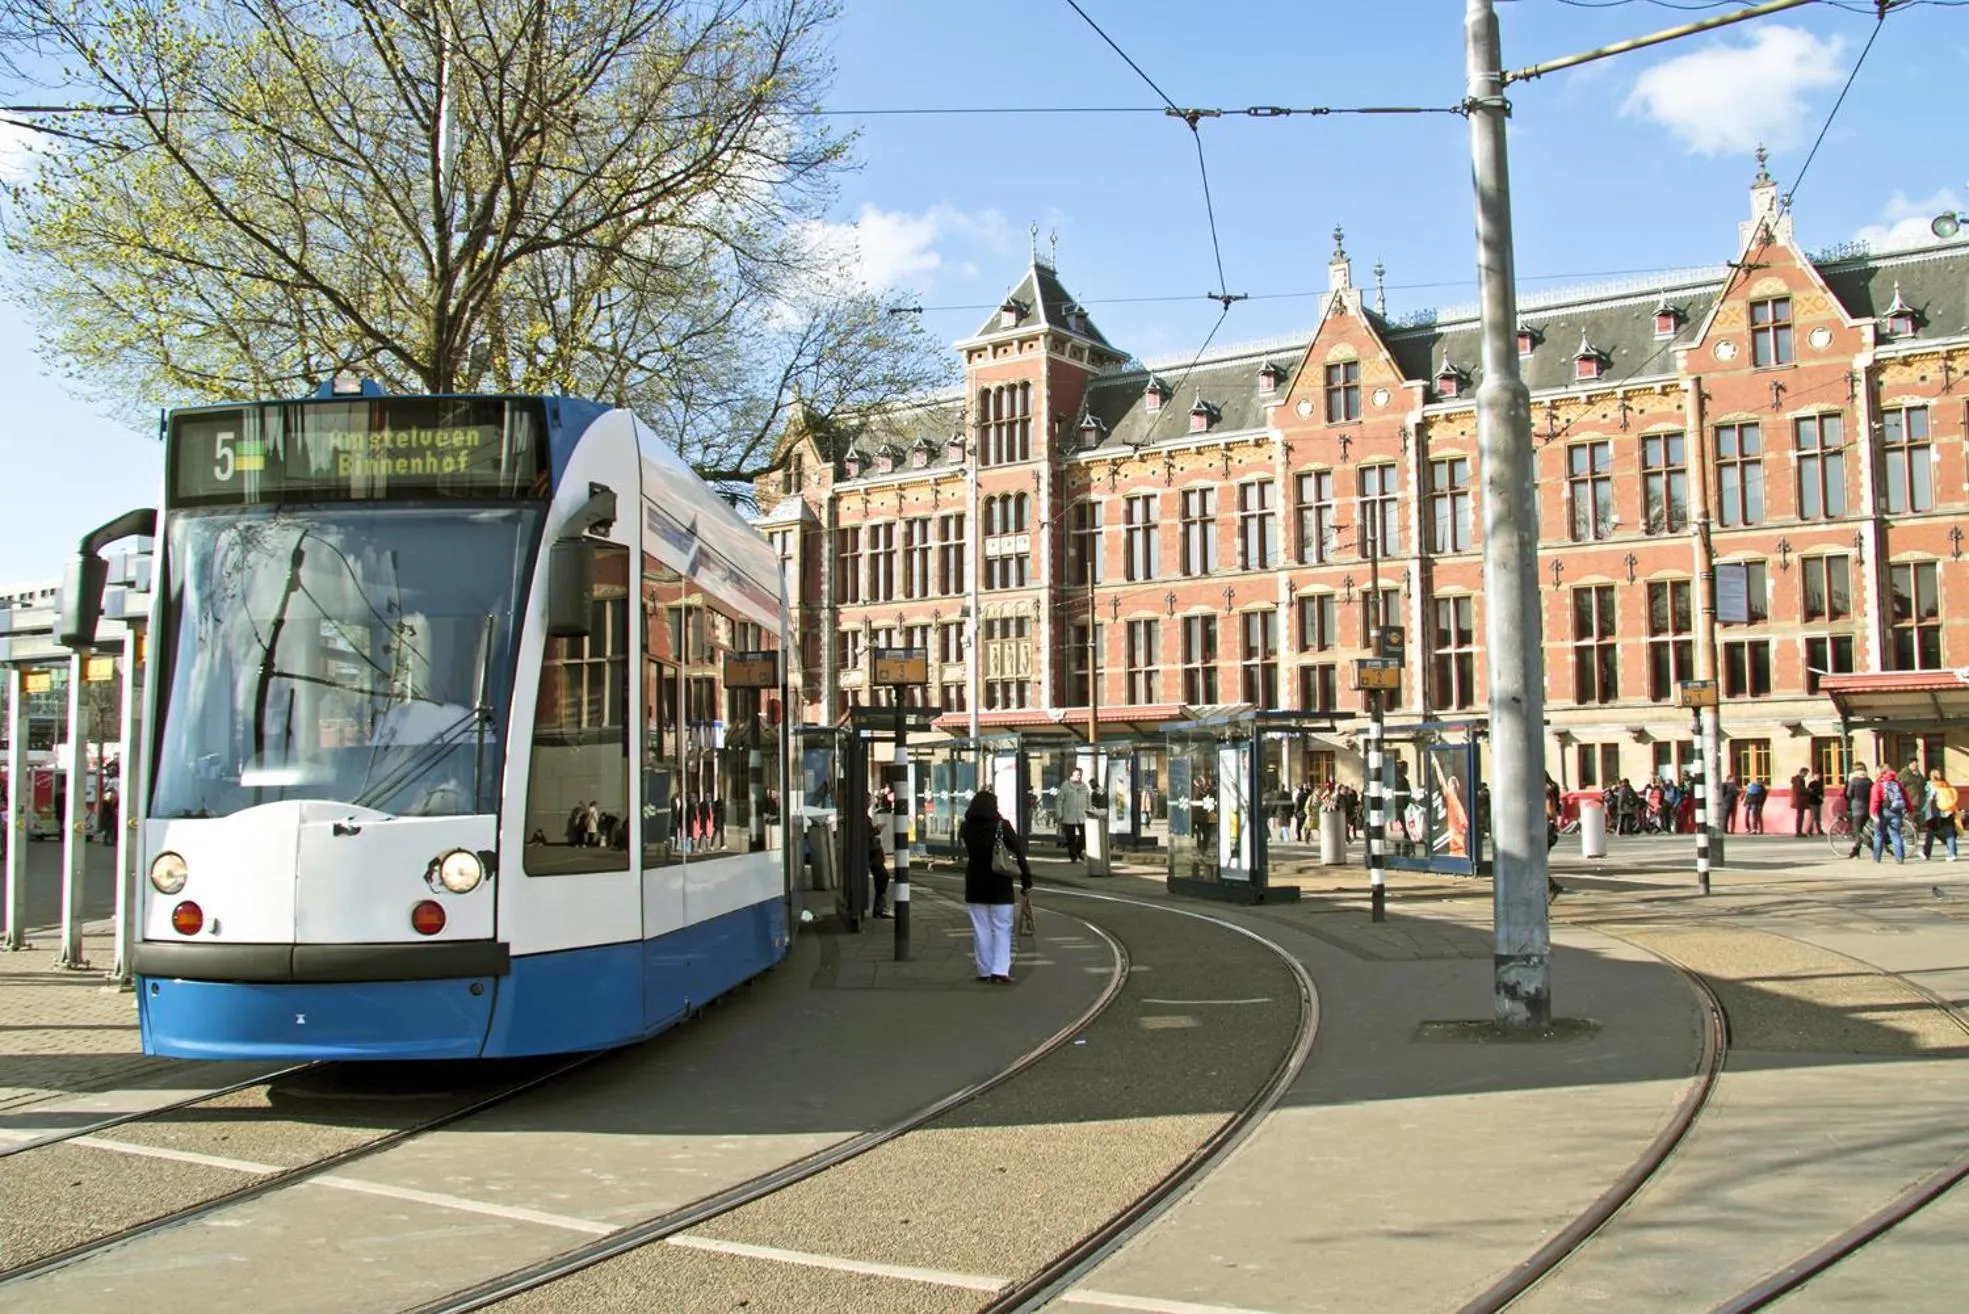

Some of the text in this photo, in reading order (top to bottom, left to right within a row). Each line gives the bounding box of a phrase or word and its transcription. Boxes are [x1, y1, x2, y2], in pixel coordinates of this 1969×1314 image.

[328, 425, 479, 452] Amstelveen
[214, 431, 235, 481] 5
[338, 449, 469, 476] Binnenhof
